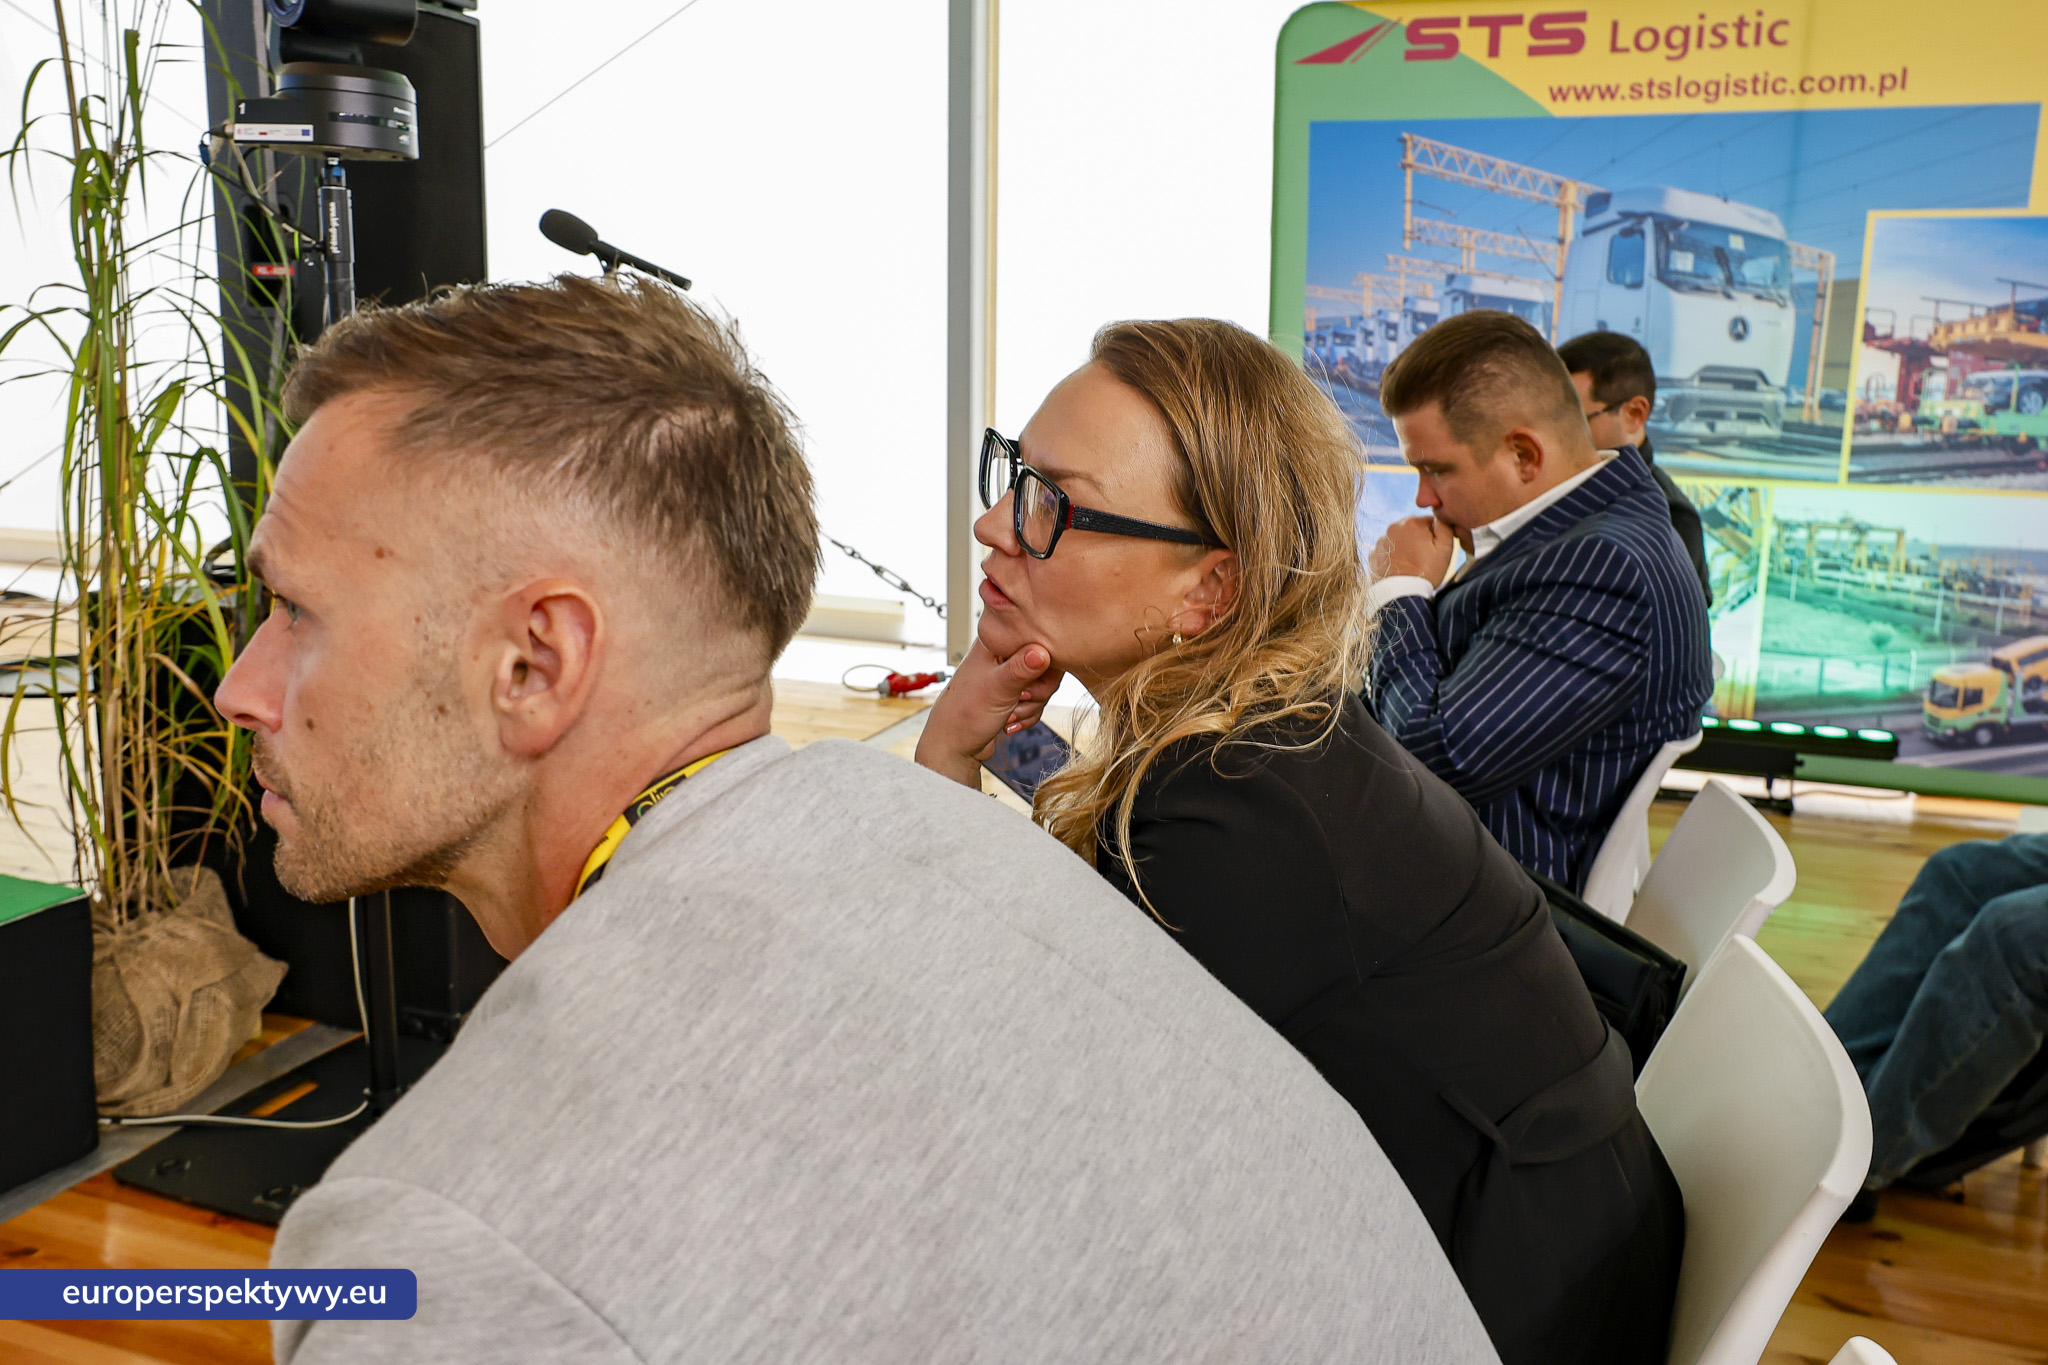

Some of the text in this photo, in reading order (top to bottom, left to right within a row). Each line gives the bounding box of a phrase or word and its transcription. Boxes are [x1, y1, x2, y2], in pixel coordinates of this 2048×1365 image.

[1404, 10, 1790, 61] STS Logistic
[1548, 66, 1908, 103] www.stslogistic.com.pl
[238, 102, 246, 115] 1
